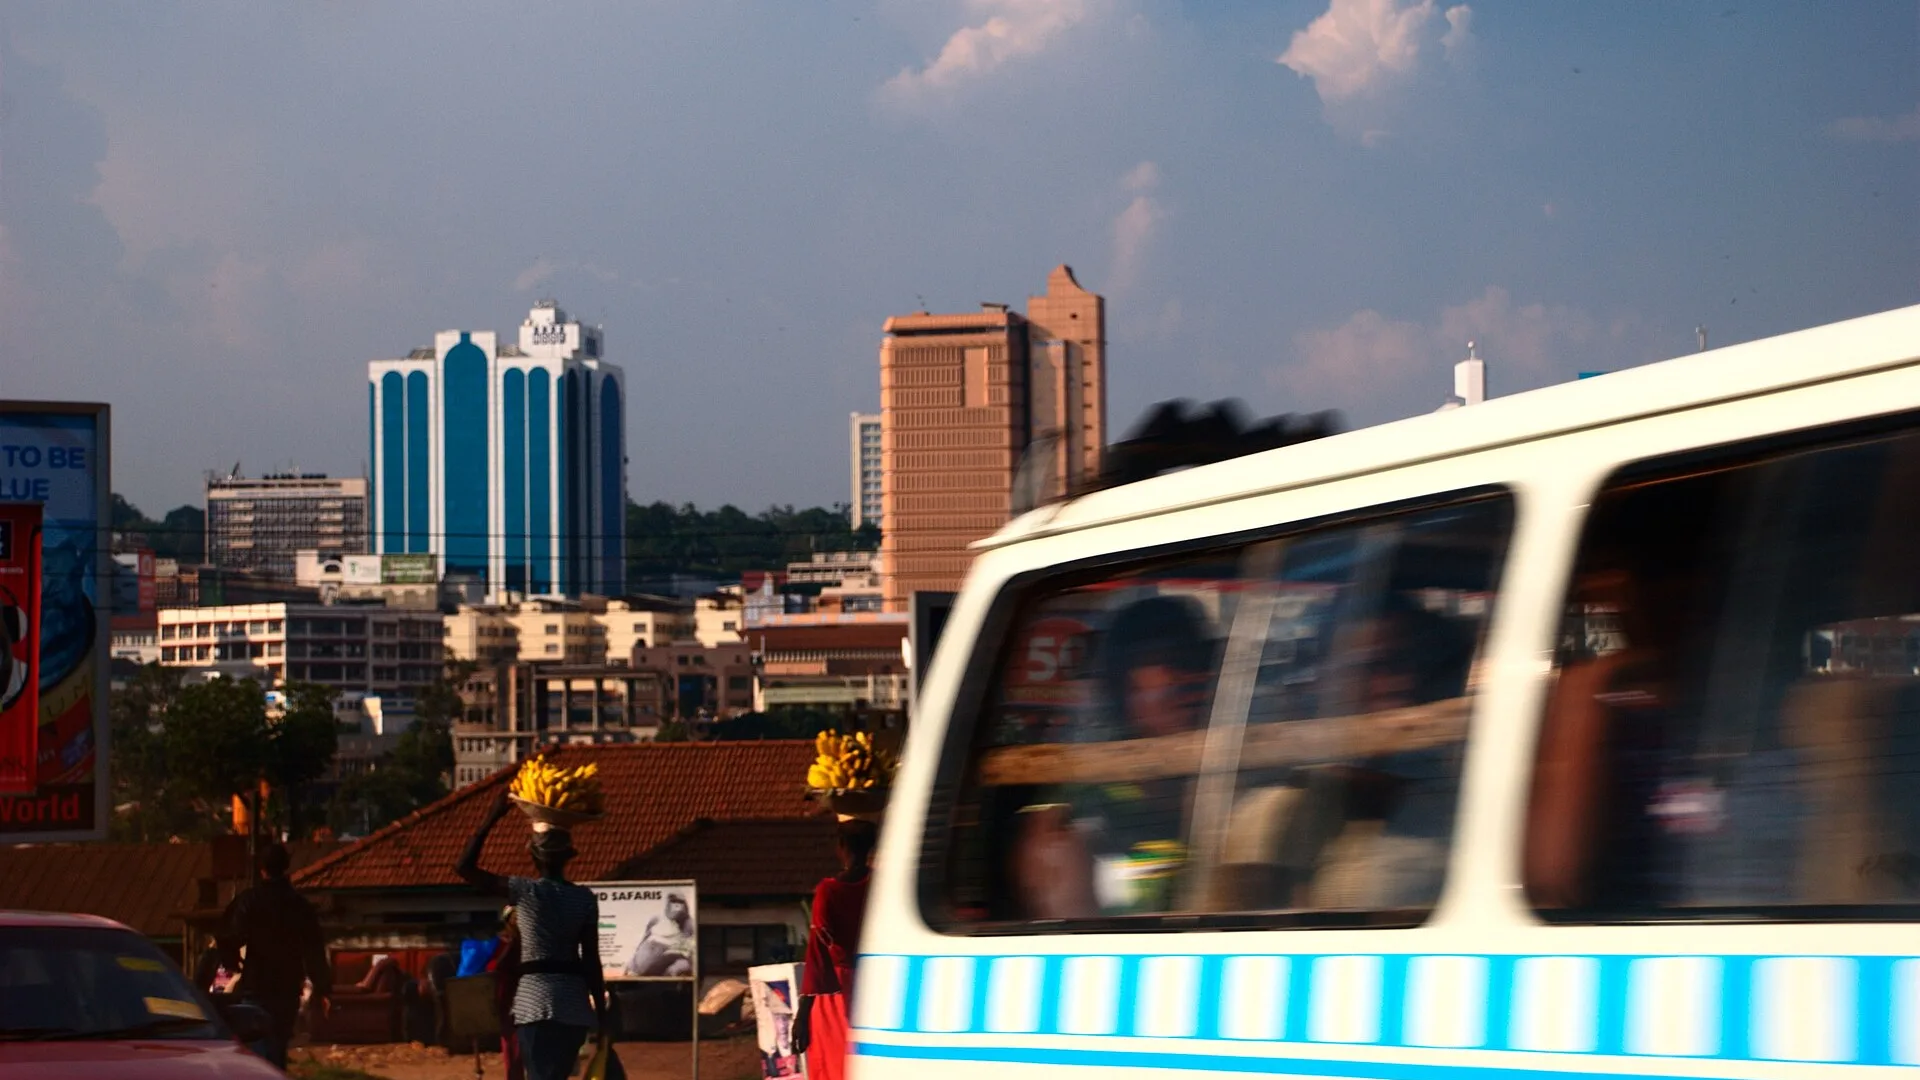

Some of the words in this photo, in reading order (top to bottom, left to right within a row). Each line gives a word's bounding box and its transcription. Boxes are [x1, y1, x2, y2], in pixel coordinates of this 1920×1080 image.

[1, 445, 41, 467] TO
[48, 446, 86, 469] BE
[612, 890, 662, 901] SAFARIS
